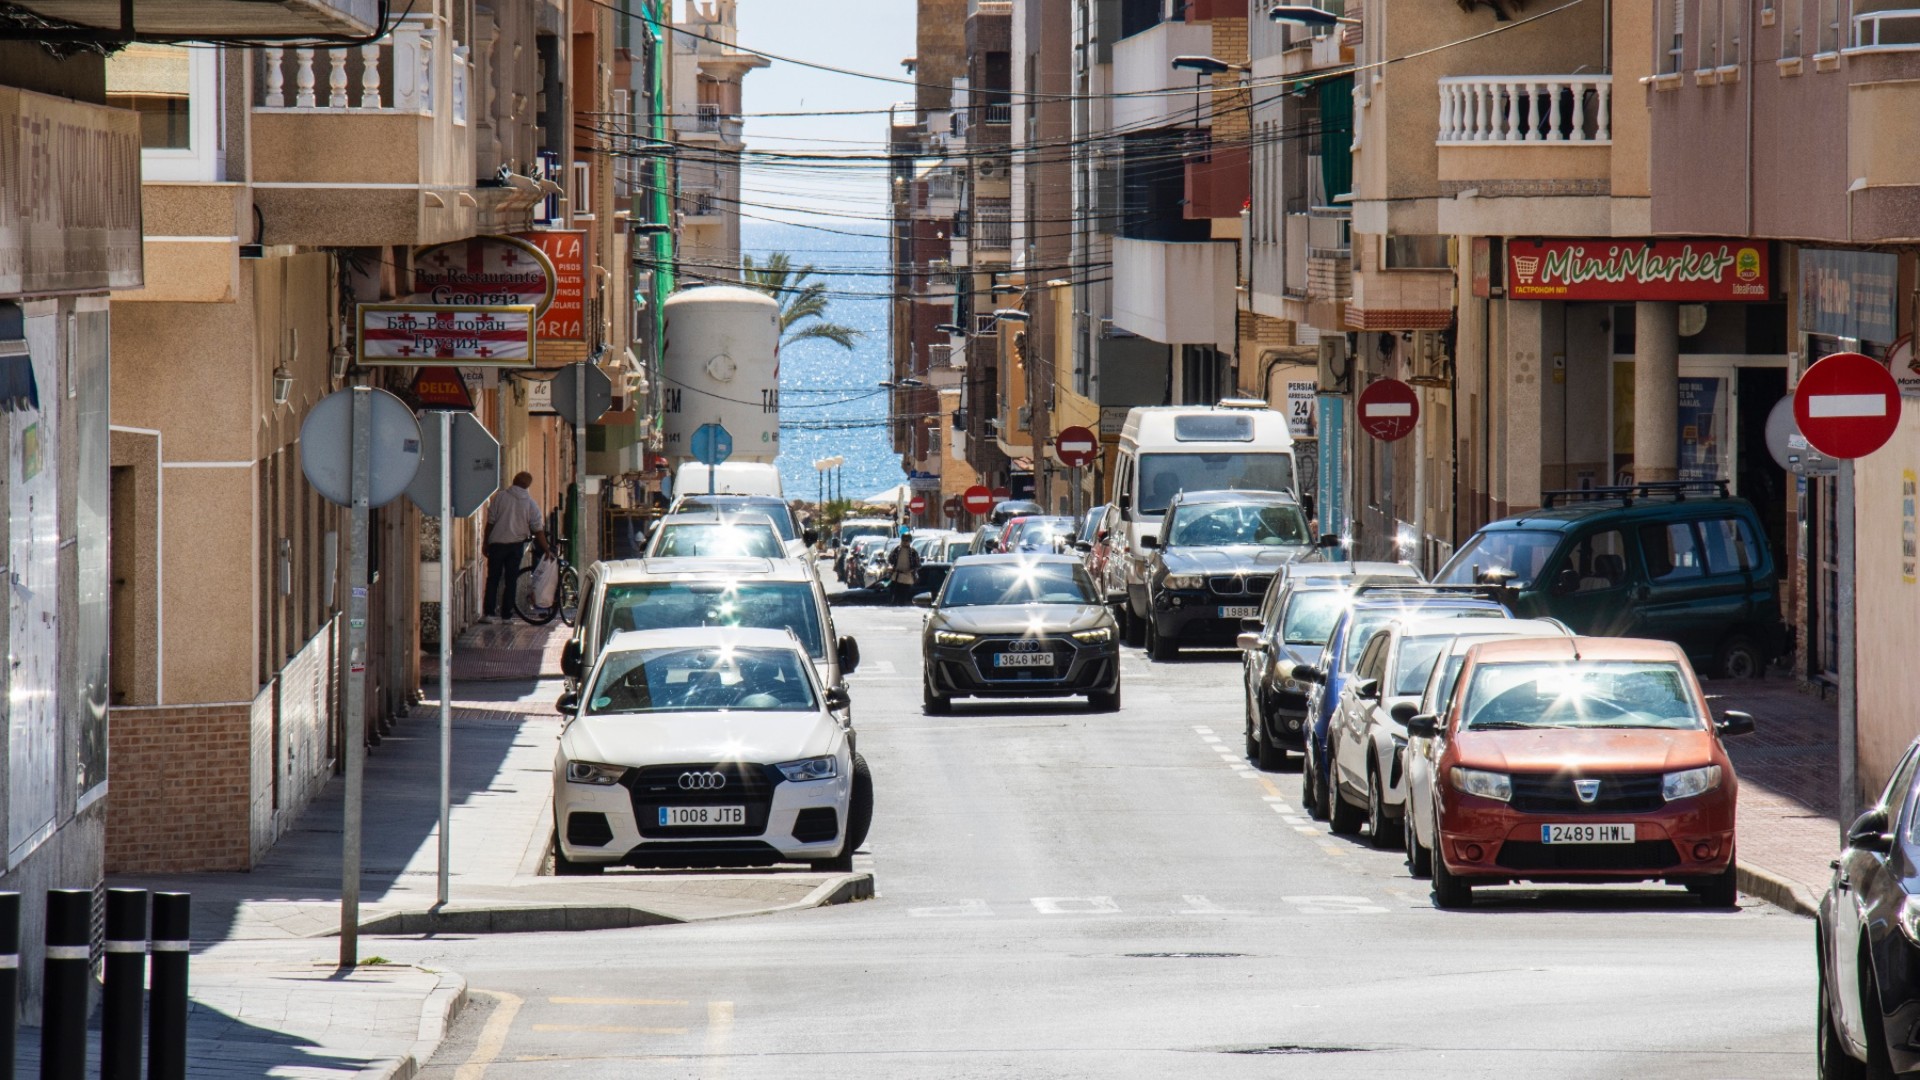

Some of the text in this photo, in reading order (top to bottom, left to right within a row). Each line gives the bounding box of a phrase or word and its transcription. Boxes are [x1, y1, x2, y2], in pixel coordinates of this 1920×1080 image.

[532, 239, 580, 258] LLA
[558, 263, 581, 271] PISOS
[1542, 244, 1734, 285] MiniMarket
[415, 268, 539, 283] Bar Restaurante
[431, 285, 520, 306] Georgia
[386, 316, 506, 335] Бар-Ресторан
[413, 333, 480, 354] Грузия
[419, 381, 460, 394] DELTA
[1294, 400, 1308, 416] 24
[1002, 653, 1051, 665] 3846 MPC
[671, 808, 742, 823] 1008 JTB
[1553, 826, 1631, 841] 2489 HWL
